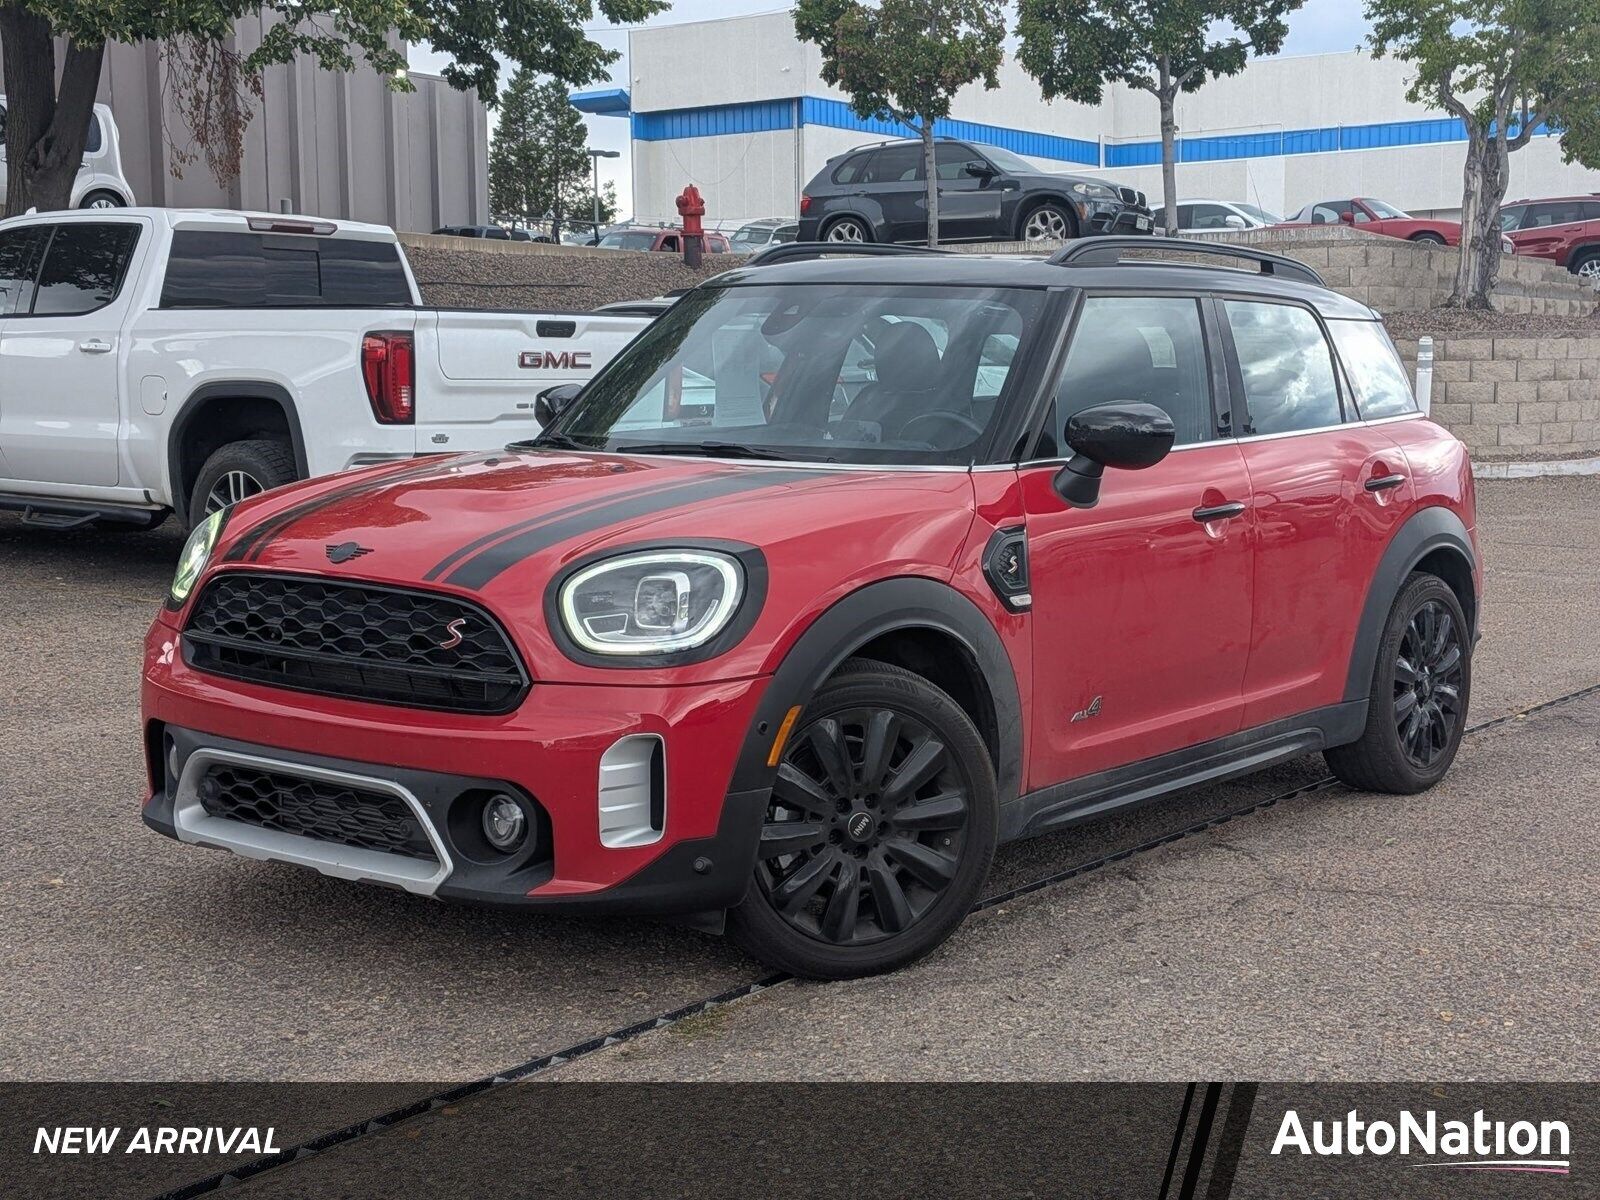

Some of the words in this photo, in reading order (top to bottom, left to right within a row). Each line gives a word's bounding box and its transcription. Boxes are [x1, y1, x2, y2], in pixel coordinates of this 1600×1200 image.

[518, 351, 592, 369] GMC
[1008, 555, 1018, 574] S
[440, 618, 466, 649] S
